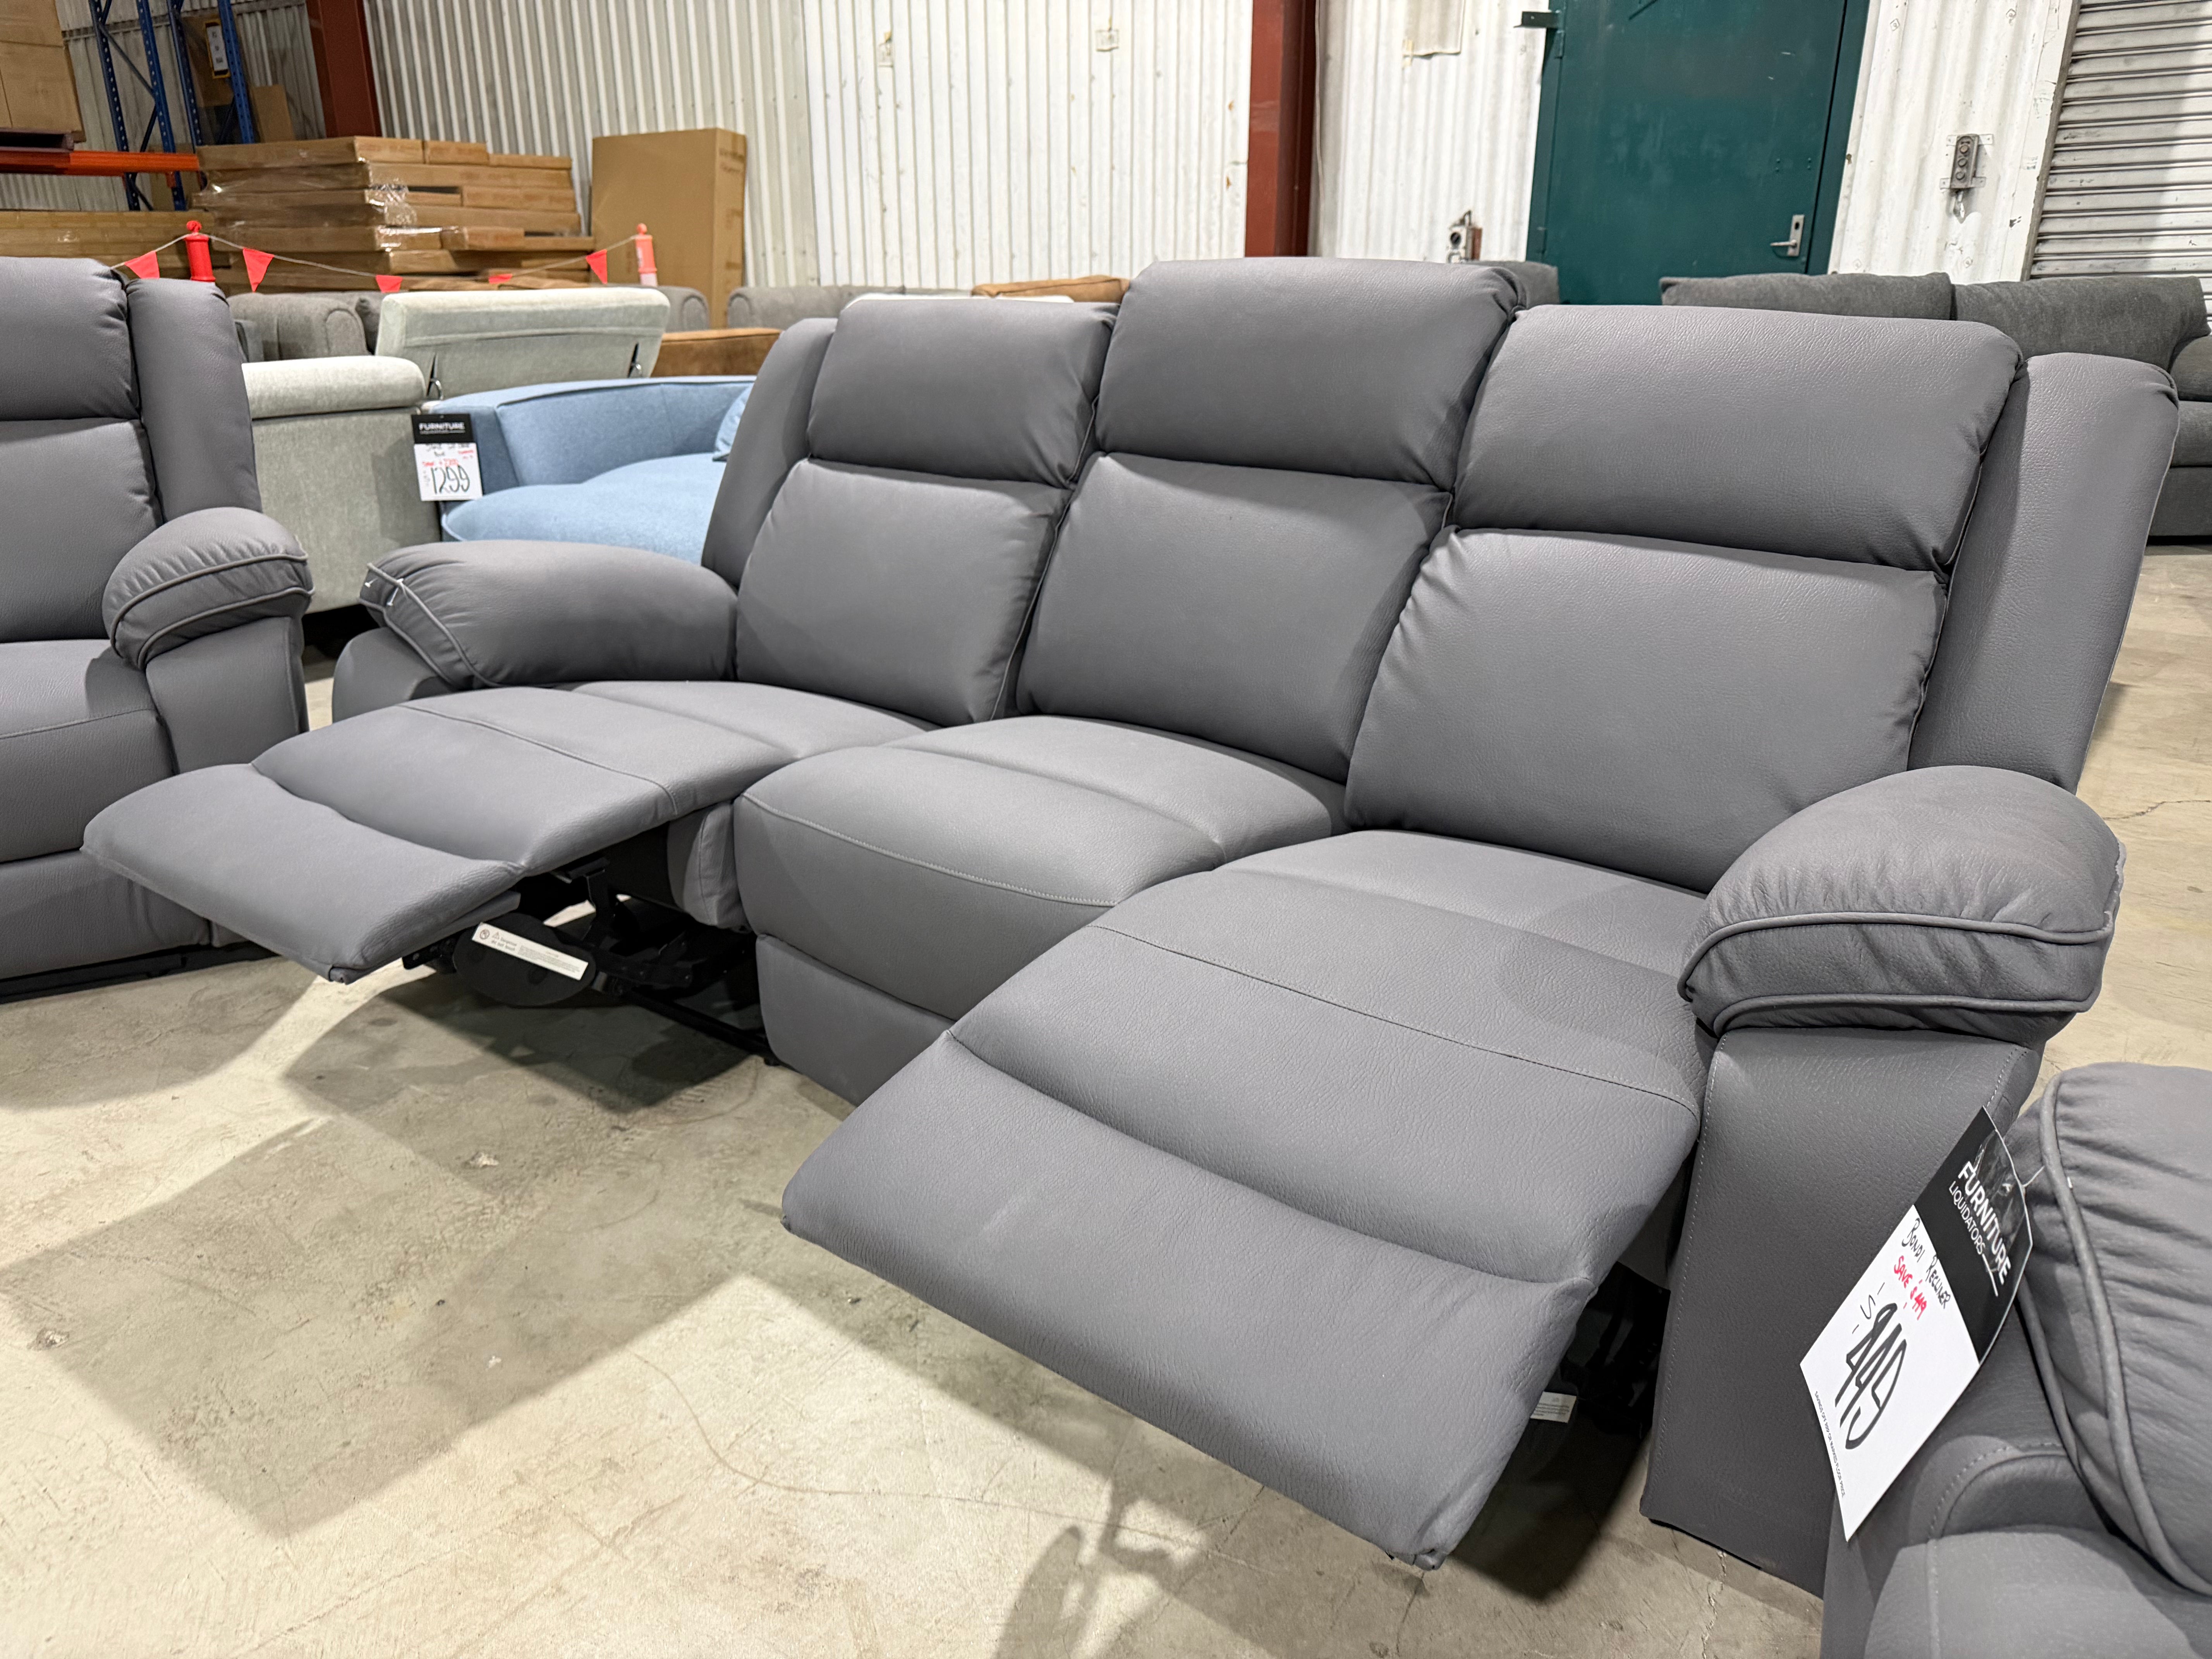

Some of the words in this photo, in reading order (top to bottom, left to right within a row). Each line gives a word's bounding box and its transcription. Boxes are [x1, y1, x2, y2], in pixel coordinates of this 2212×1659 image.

[1949, 1181, 1986, 1255] LIQUIDATORS
[1958, 1161, 2011, 1286] FURNITURE
[1894, 1255, 1913, 1289] SAVE
